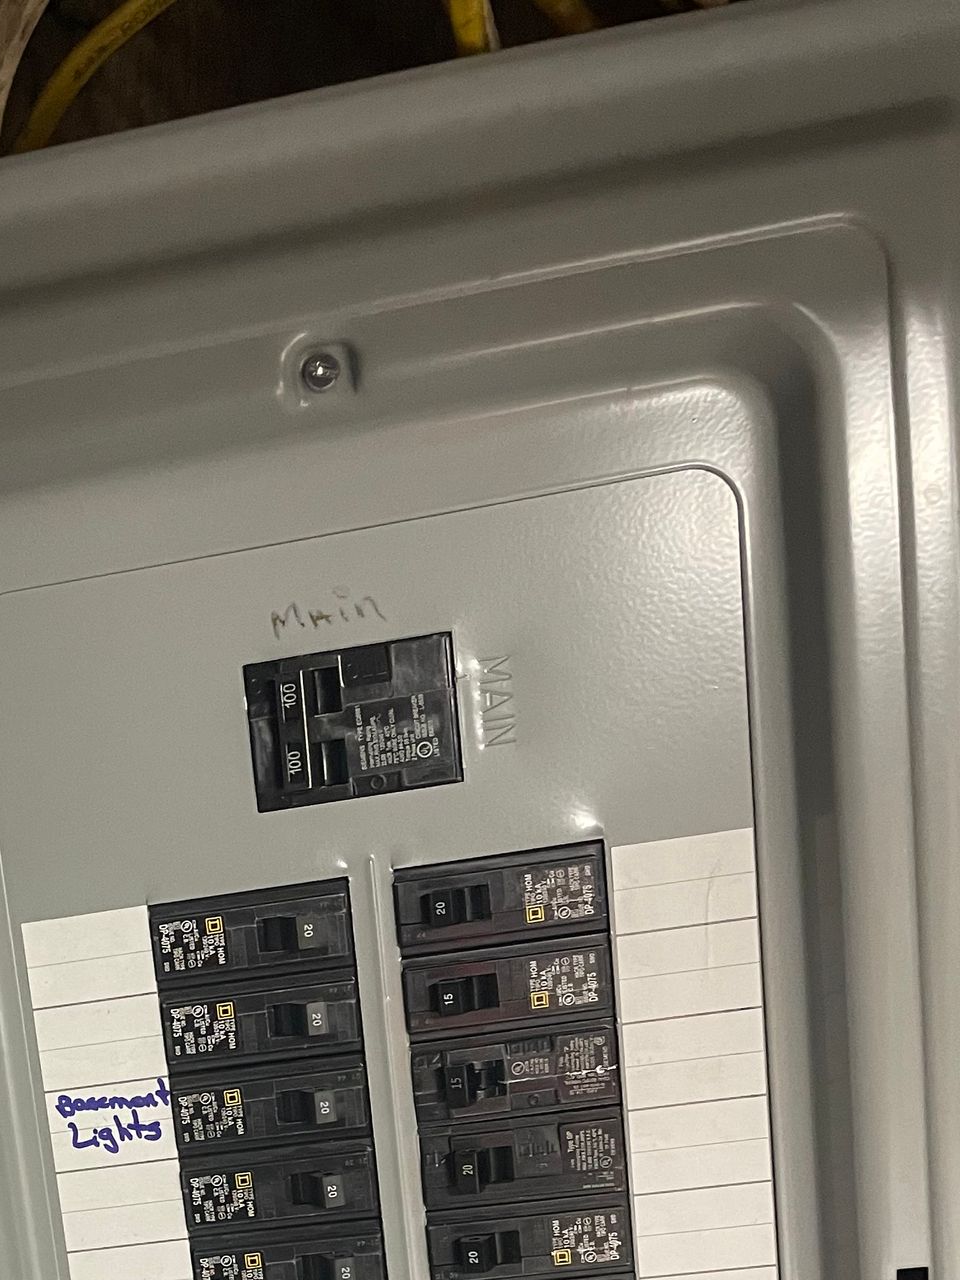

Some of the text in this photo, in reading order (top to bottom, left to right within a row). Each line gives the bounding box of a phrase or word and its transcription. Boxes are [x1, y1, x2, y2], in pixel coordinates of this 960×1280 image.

[284, 683, 296, 708] 100
[478, 655, 517, 748] MAIN
[289, 751, 301, 774] 100
[524, 874, 532, 891] HOM
[583, 884, 594, 914] DP-4075
[436, 902, 446, 915] 20
[159, 924, 171, 953] DP-4075
[304, 924, 313, 937] 20
[217, 947, 226, 964] HOM
[530, 961, 538, 978] HOM
[587, 972, 599, 1002] DP-4075
[443, 993, 454, 1005] 15
[170, 1009, 182, 1037] DP-4075
[312, 1013, 321, 1026] 20
[228, 1032, 236, 1049] HOM
[451, 1077, 462, 1089] 15
[178, 1096, 190, 1124] DP-4075
[320, 1102, 330, 1114] 20
[68, 1108, 162, 1154] Lights
[236, 1119, 244, 1135] HOM
[462, 1164, 473, 1175] 20
[190, 1178, 201, 1205] DP-4075
[327, 1186, 337, 1197] 20
[246, 1201, 255, 1216] HOM
[552, 1220, 560, 1236] HOM
[608, 1232, 620, 1260] DP-4075
[469, 1251, 478, 1264] 20
[341, 1268, 350, 1279] 20
